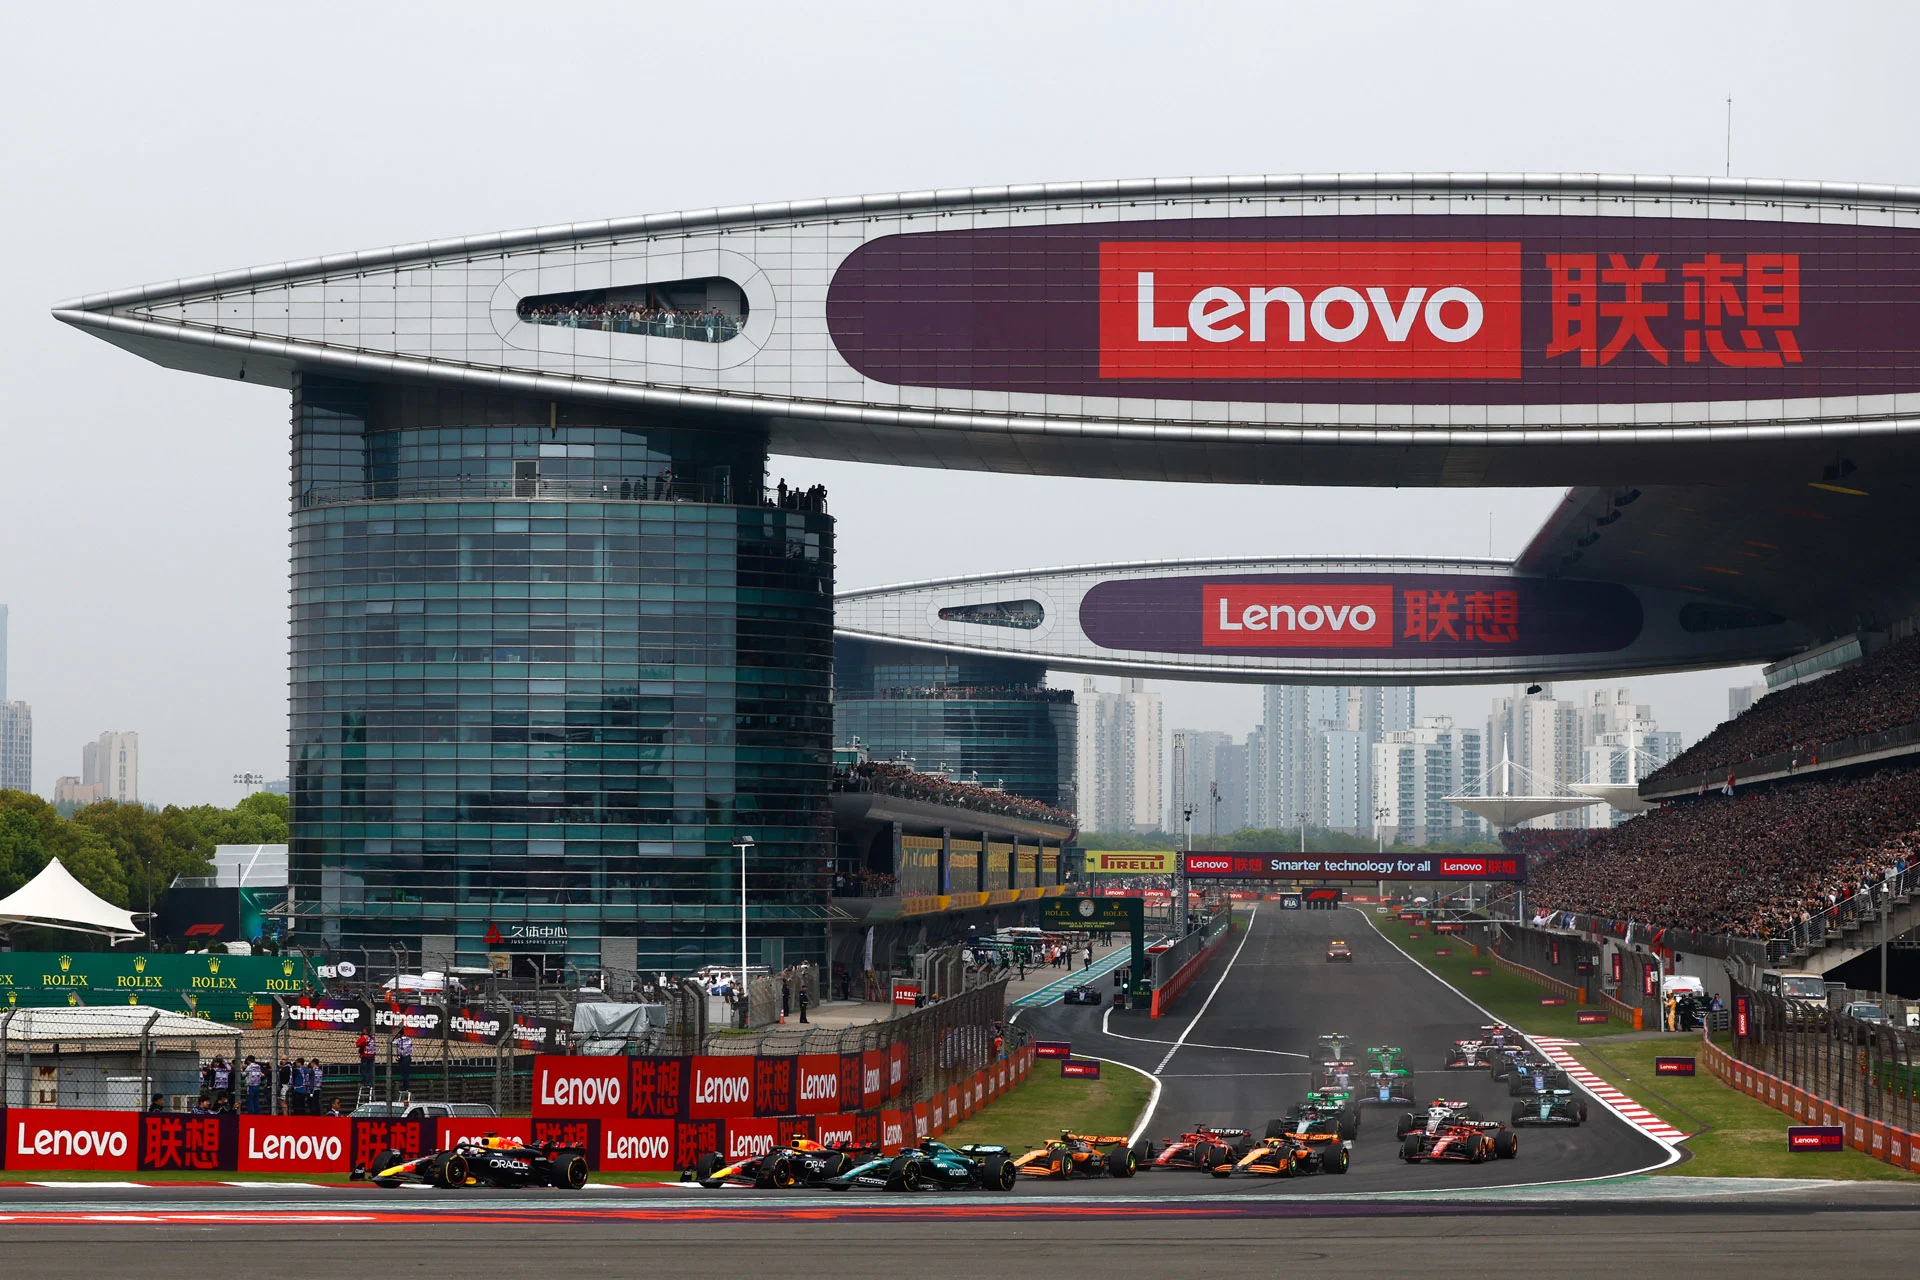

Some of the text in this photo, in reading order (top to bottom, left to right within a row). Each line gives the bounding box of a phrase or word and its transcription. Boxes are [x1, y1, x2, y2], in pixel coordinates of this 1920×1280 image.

[1137, 253, 1803, 368] Lenovo 联想
[1219, 590, 1519, 643] Lenovo 联想
[1101, 854, 1164, 869] PIRELLI
[1190, 858, 1262, 872] Lenovo 联想
[1271, 859, 1431, 873] Smarter technology for all
[1443, 862, 1483, 871] Lenovo
[1105, 887, 1125, 896] Lenovo
[1284, 899, 1297, 907] FIA
[511, 925, 568, 938] 久体中心
[42, 975, 88, 986] ROLEX
[117, 976, 163, 987] ROLEX
[192, 977, 237, 989] ROLEX
[375, 1010, 439, 1029] #ChineseGP
[450, 1016, 500, 1036] #ChineseGP
[541, 1060, 680, 1116] Lenovo 联想
[695, 1060, 790, 1112] Lenovo 联想
[800, 1068, 837, 1100] Lenovo
[864, 1063, 880, 1094] Lenovo
[17, 1117, 220, 1169] Lenovo 联想
[883, 1121, 902, 1146] Lenovo
[249, 1128, 342, 1160] Lenovo
[607, 1131, 669, 1159] Lenovo
[730, 1130, 774, 1157] Lenovo
[490, 1159, 529, 1170] ORACLE
